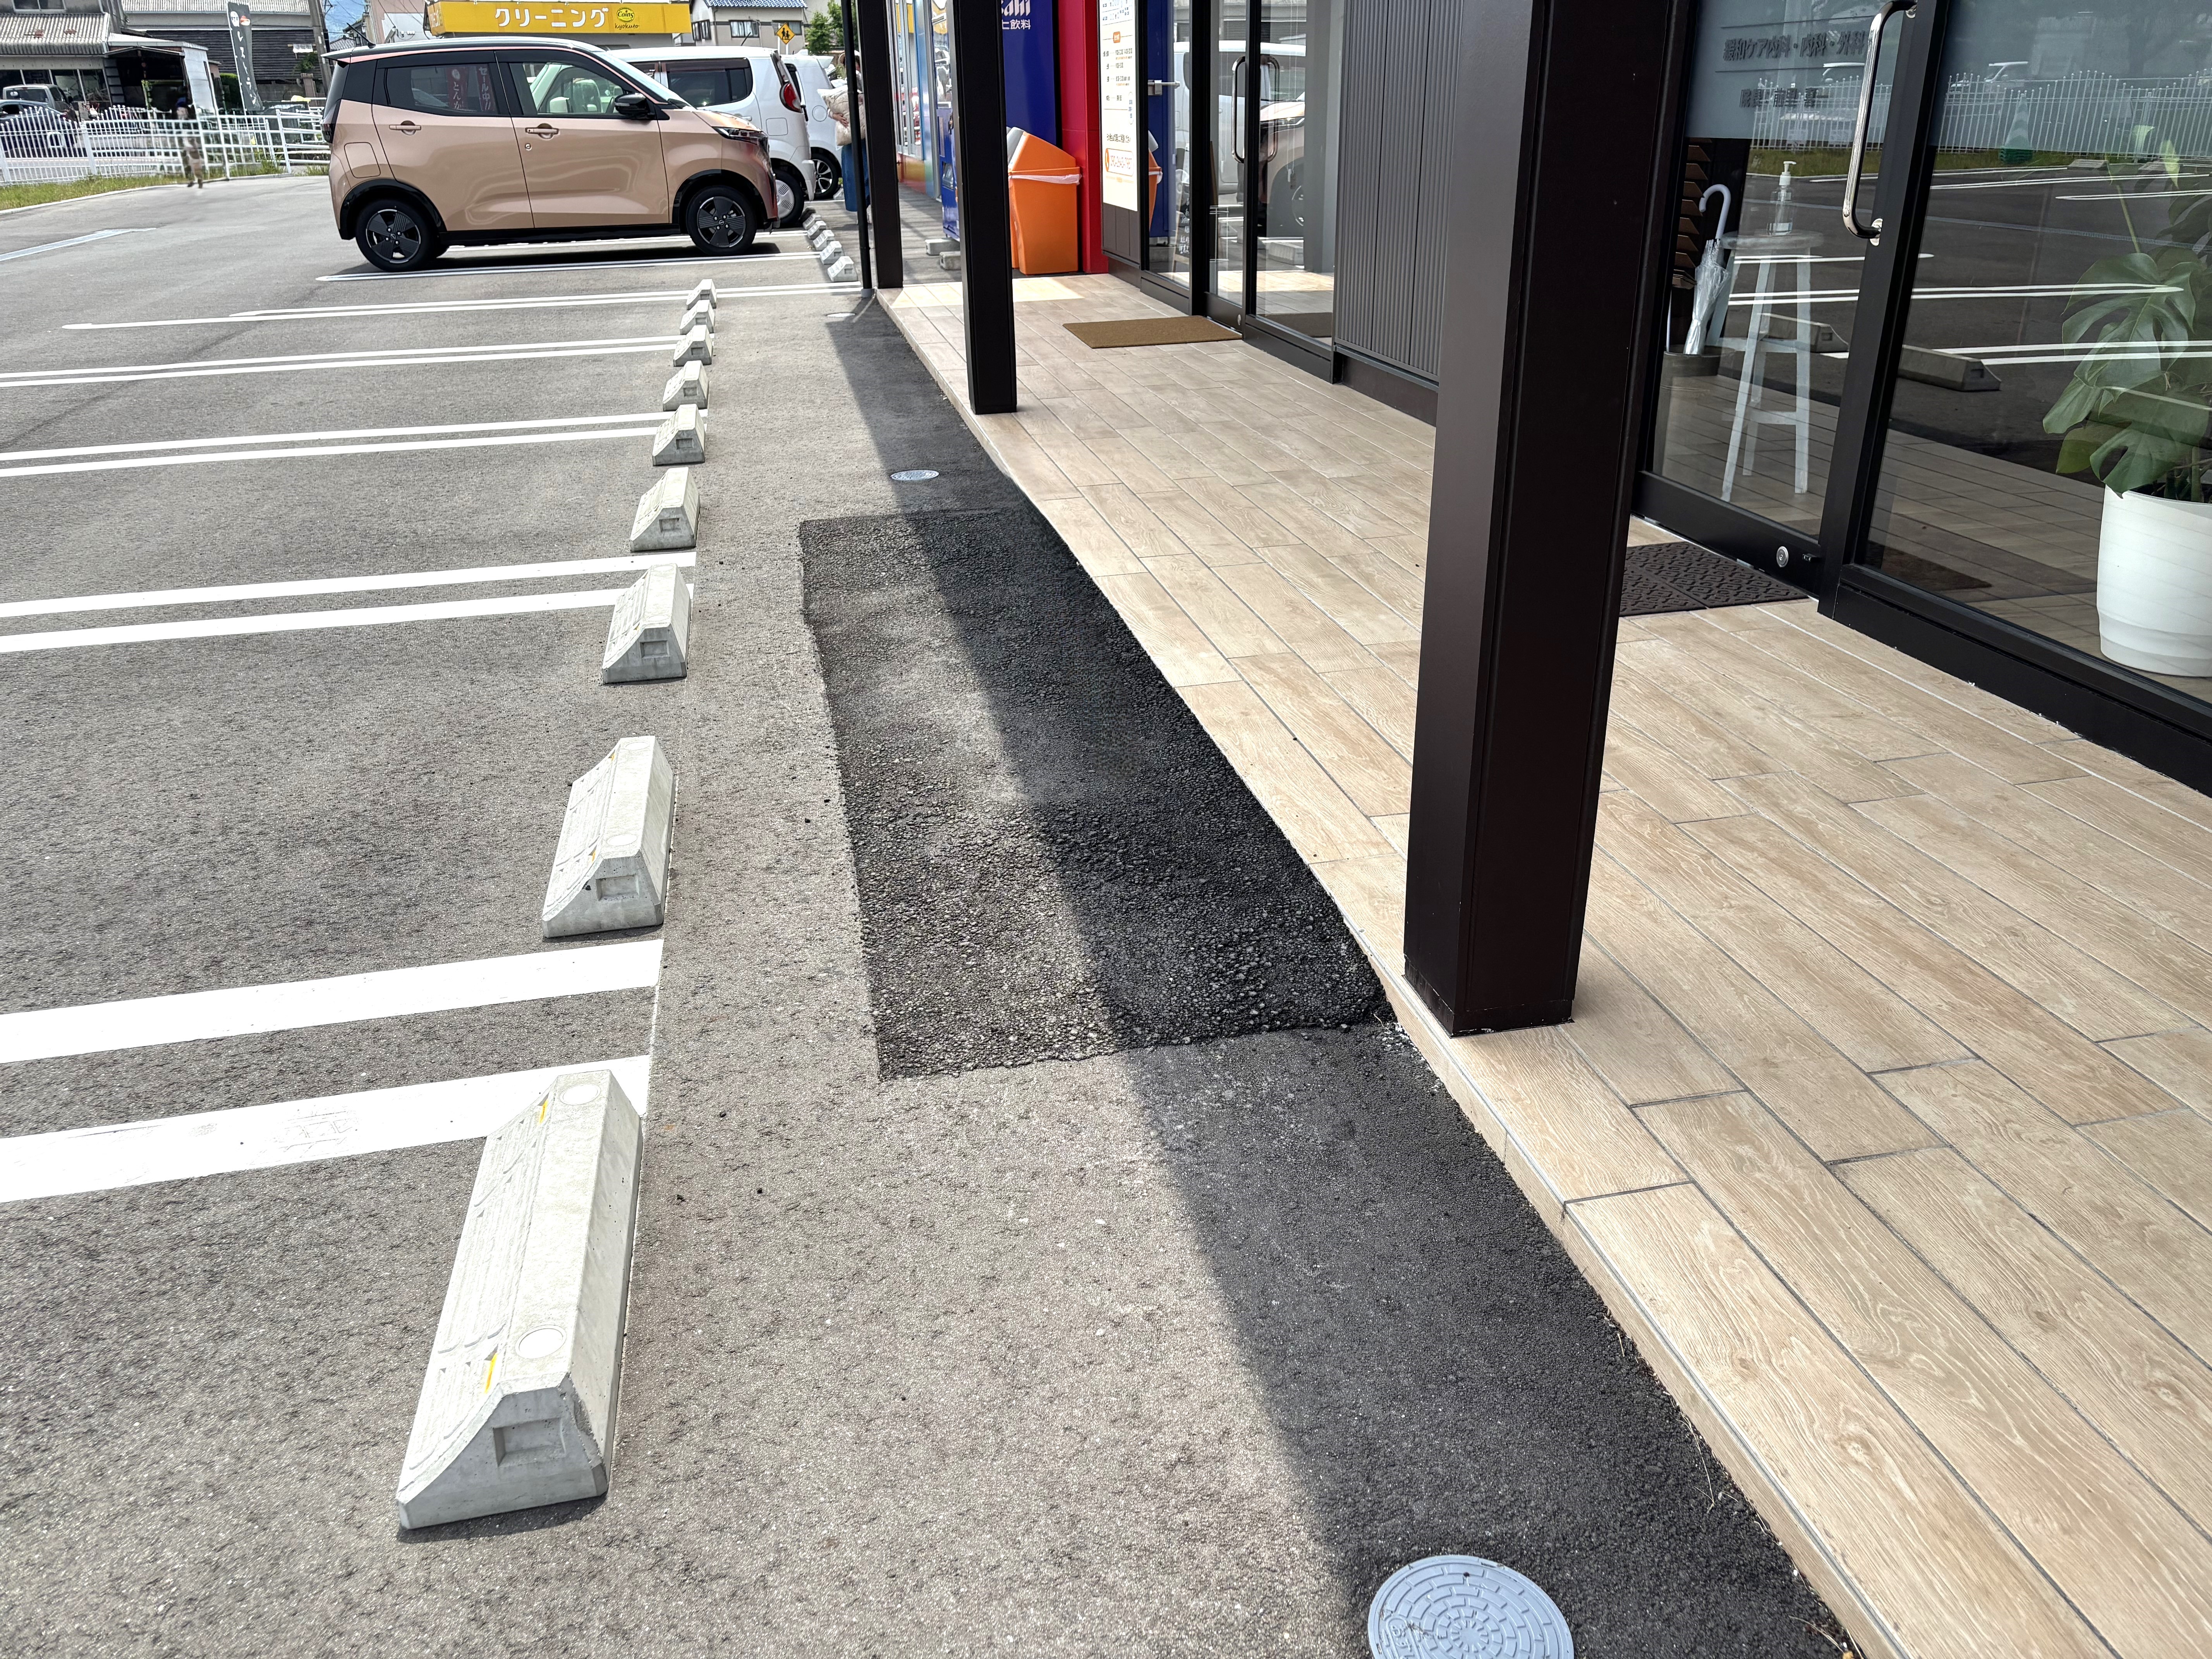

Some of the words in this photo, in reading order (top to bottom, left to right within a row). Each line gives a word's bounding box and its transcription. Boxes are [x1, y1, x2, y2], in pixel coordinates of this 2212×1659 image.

[495, 8, 609, 27] クリーニング
[237, 31, 256, 105] レストラン
